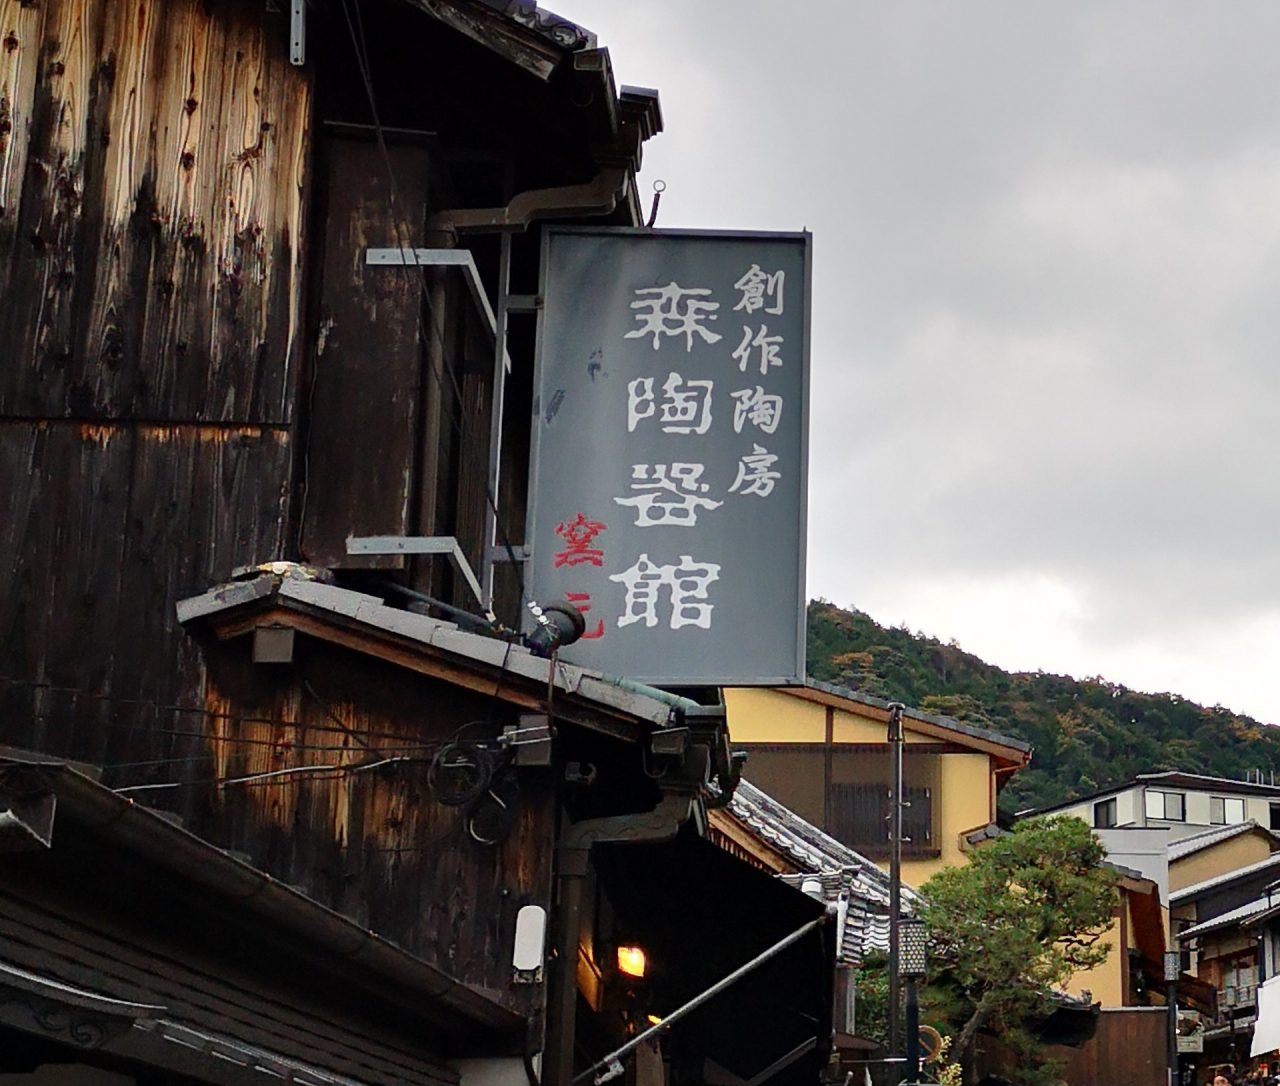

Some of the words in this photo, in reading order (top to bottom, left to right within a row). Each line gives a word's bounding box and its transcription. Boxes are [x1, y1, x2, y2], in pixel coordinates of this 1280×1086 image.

[608, 281, 724, 630] 森陶器館
[727, 264, 785, 498] 創作陶房
